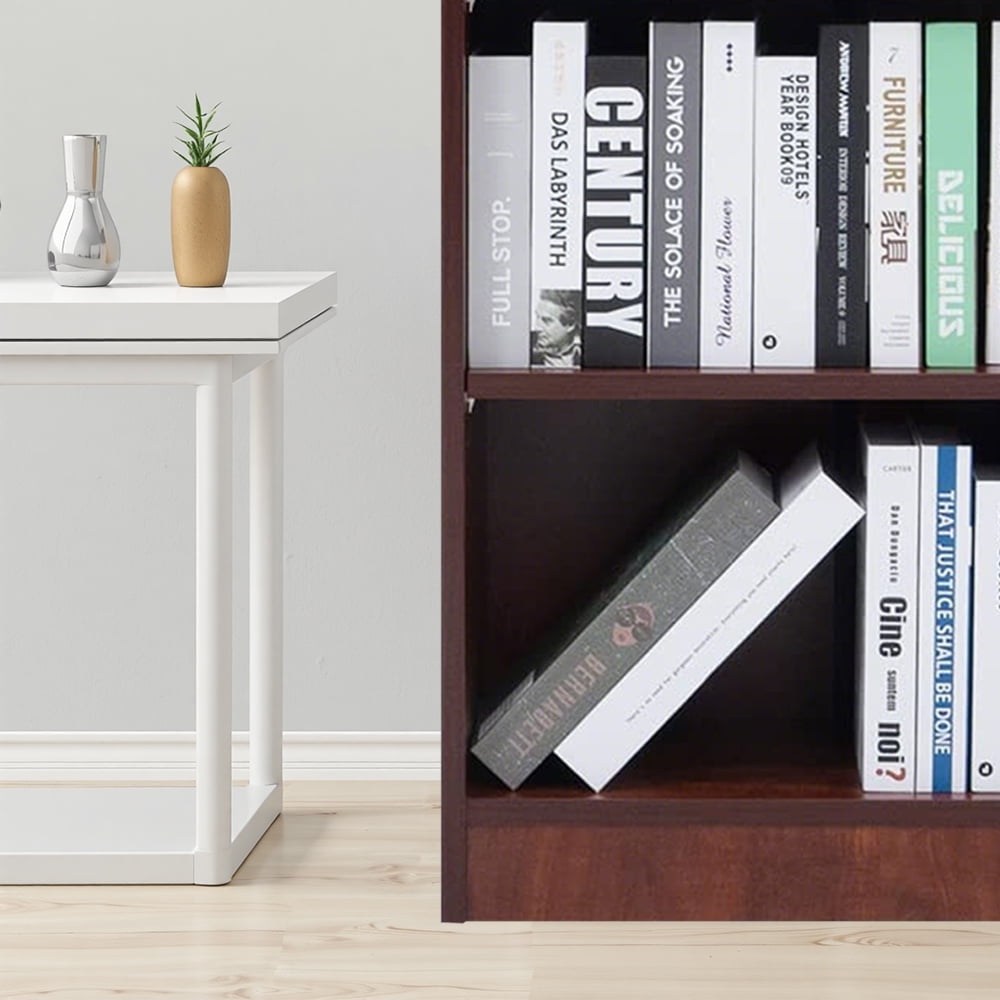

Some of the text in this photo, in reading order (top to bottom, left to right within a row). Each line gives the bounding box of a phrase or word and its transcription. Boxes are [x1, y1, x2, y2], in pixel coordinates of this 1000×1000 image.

[781, 76, 794, 115] YEAR
[839, 41, 850, 94] ANDREW
[551, 113, 568, 150] DAS
[795, 76, 809, 200] DESIGN HOTELS
[839, 93, 849, 137] MARTIN
[883, 77, 906, 193] FURNITURE
[664, 57, 684, 327] THE SOLACE OF SOAKING
[838, 148, 848, 192] INTERIOR
[550, 158, 567, 266] LABYRINTH
[583, 84, 644, 336] CENTURY
[838, 195, 848, 230] DESIGN
[881, 211, 908, 264] 家具
[493, 196, 511, 327] FULL STOP.
[716, 198, 733, 346] National Flower
[838, 233, 847, 269] REVIEW
[938, 170, 964, 337] DELICIOUS
[838, 276, 846, 312] VOLUME
[879, 597, 907, 657] Cine
[934, 491, 955, 755] THAT JUSTICE SHALL BE DONE
[887, 670, 897, 711] suntem
